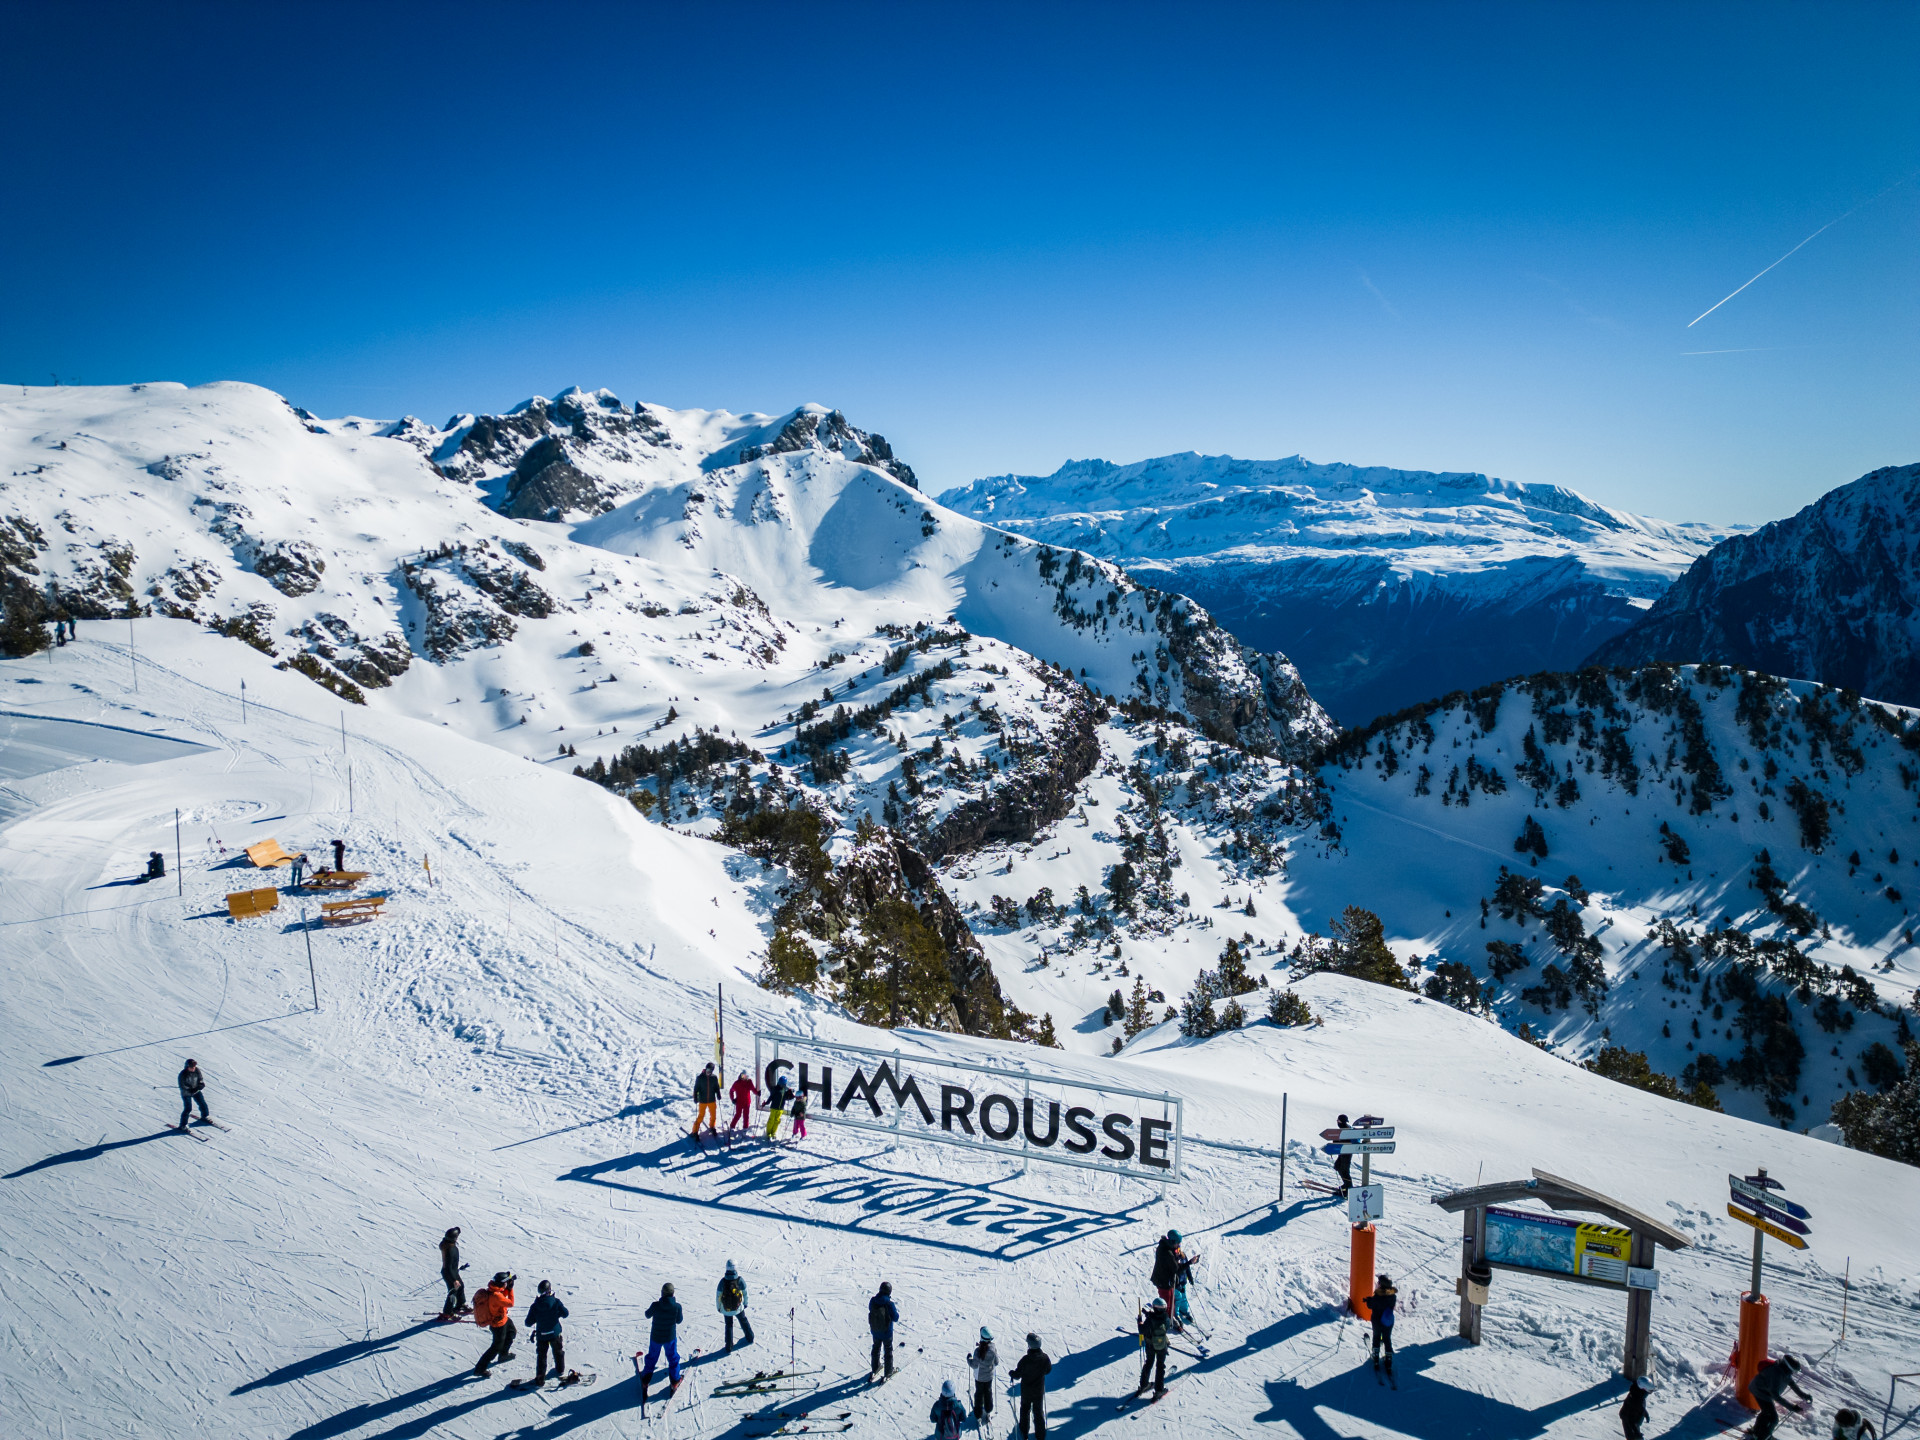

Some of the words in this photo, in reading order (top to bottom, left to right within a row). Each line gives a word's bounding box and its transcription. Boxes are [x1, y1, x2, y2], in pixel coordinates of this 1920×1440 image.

[764, 1059, 1172, 1168] CHAMROUSSE
[1734, 1193, 1770, 1215] Chamrousse
[1772, 1212, 1786, 1222] 1750
[1740, 1183, 1786, 1208] Bachat-Bouloud
[1521, 1214, 1548, 1222] Bérangère
[1730, 1208, 1760, 1227] Snowpark
[1766, 1224, 1776, 1234] Kid
[1777, 1230, 1792, 1242] Park
